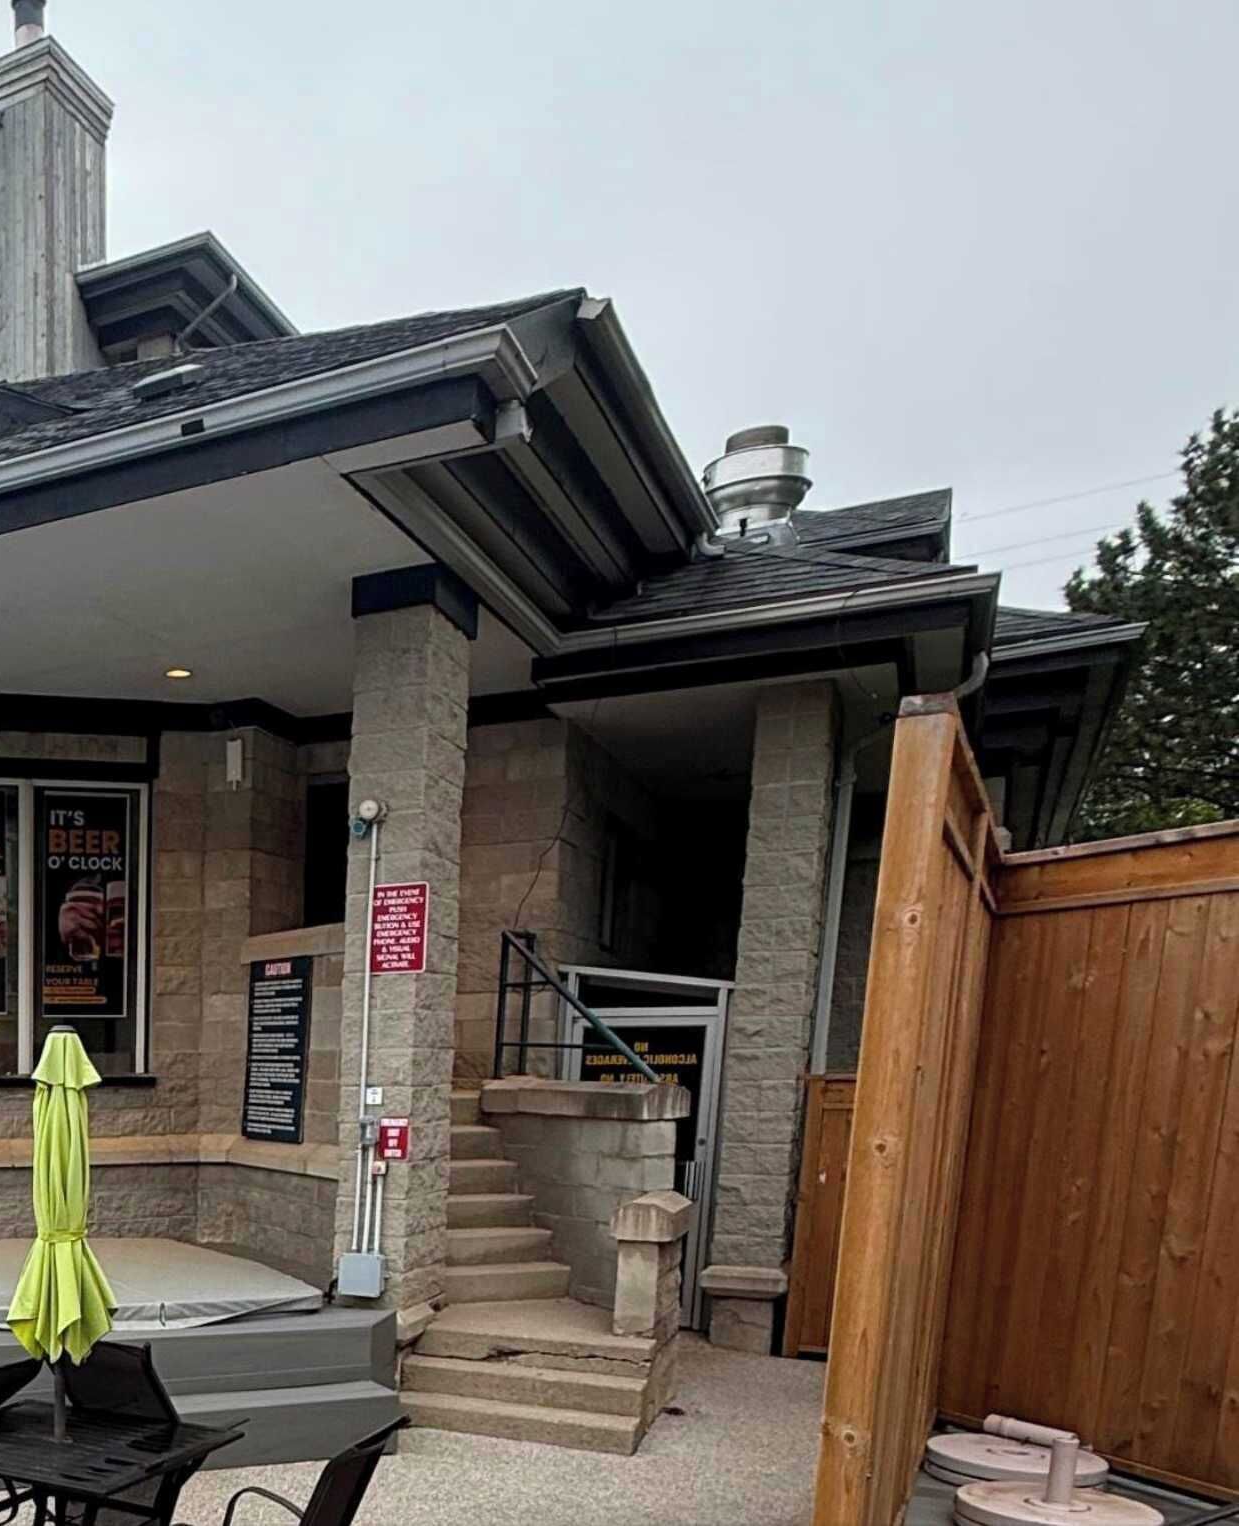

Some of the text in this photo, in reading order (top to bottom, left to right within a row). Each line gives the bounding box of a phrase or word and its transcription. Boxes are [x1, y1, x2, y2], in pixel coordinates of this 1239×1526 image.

[50, 809, 86, 827] IT'S
[48, 829, 121, 854] BEER
[383, 897, 425, 906] EMERGENCY
[376, 912, 417, 922] EMERGENCY
[376, 929, 417, 937] EMERGENCY
